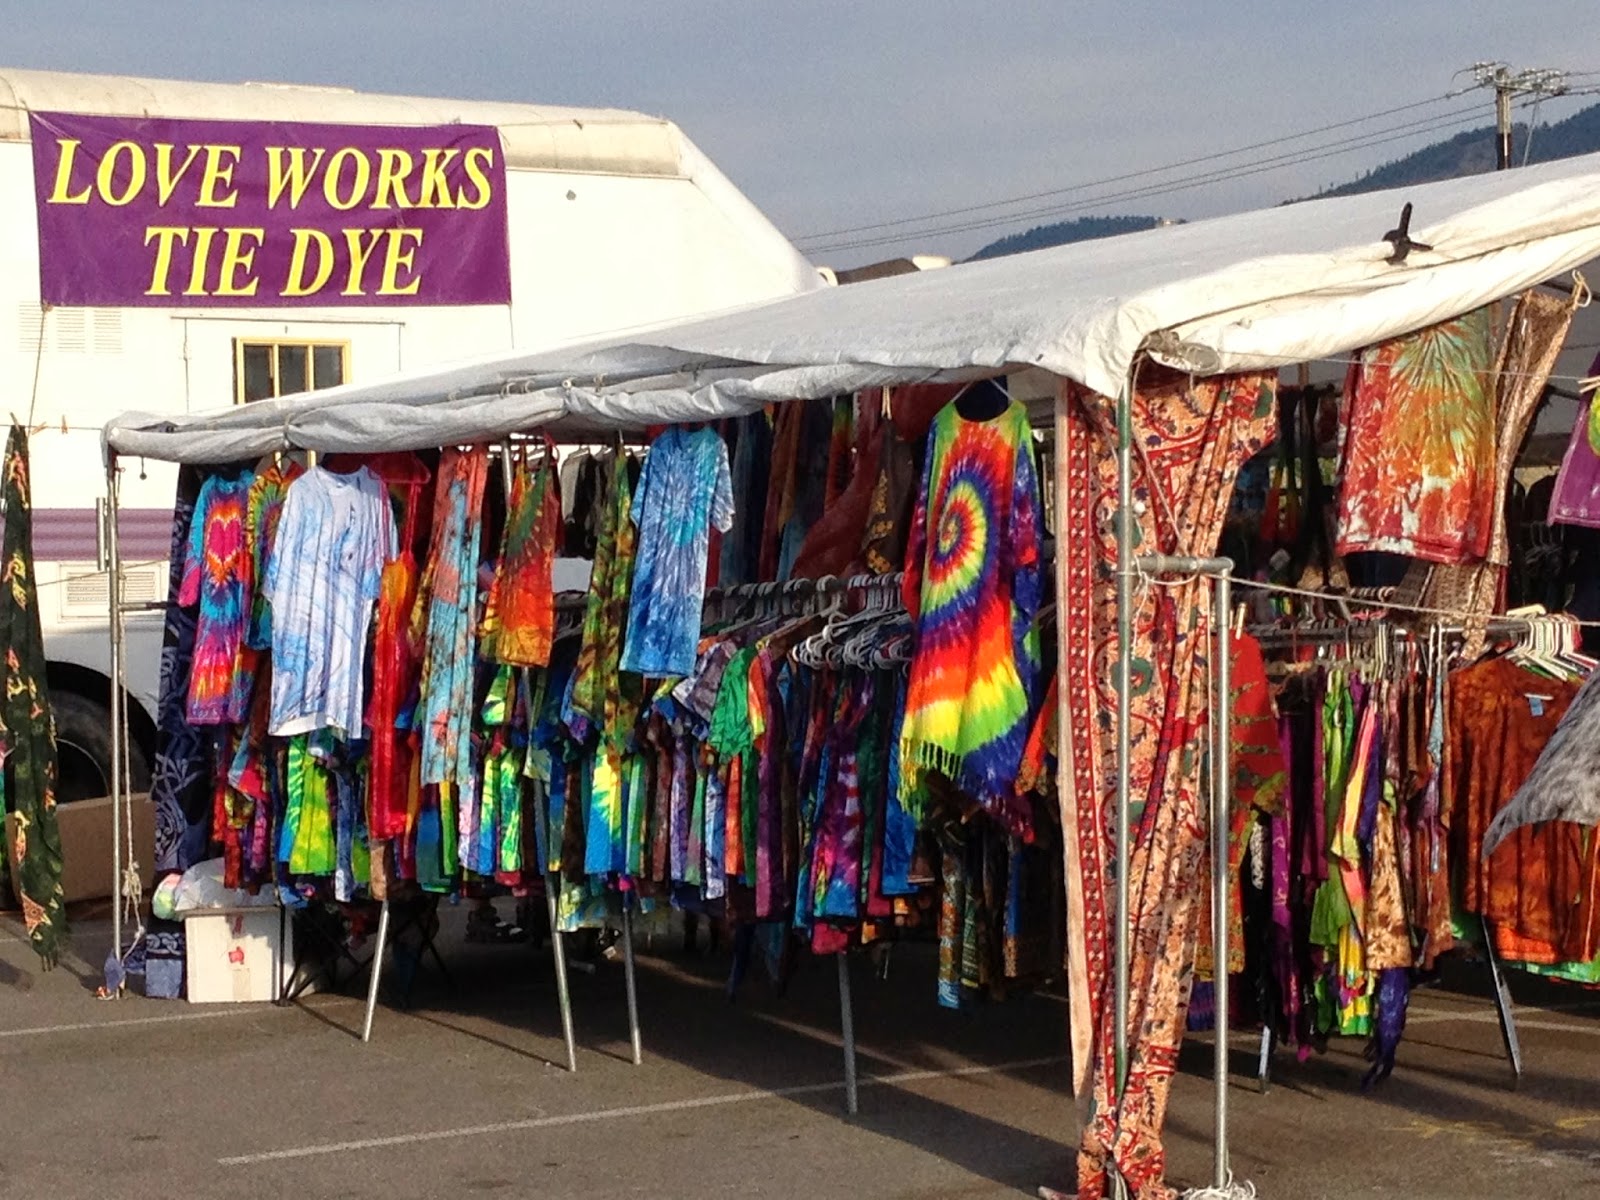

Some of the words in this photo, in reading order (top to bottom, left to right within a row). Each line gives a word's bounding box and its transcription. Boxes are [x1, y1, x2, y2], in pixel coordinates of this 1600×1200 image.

[47, 138, 242, 208] LOVE
[264, 146, 494, 211] WORKS
[143, 226, 265, 297] TIE
[278, 227, 424, 297] DYE
